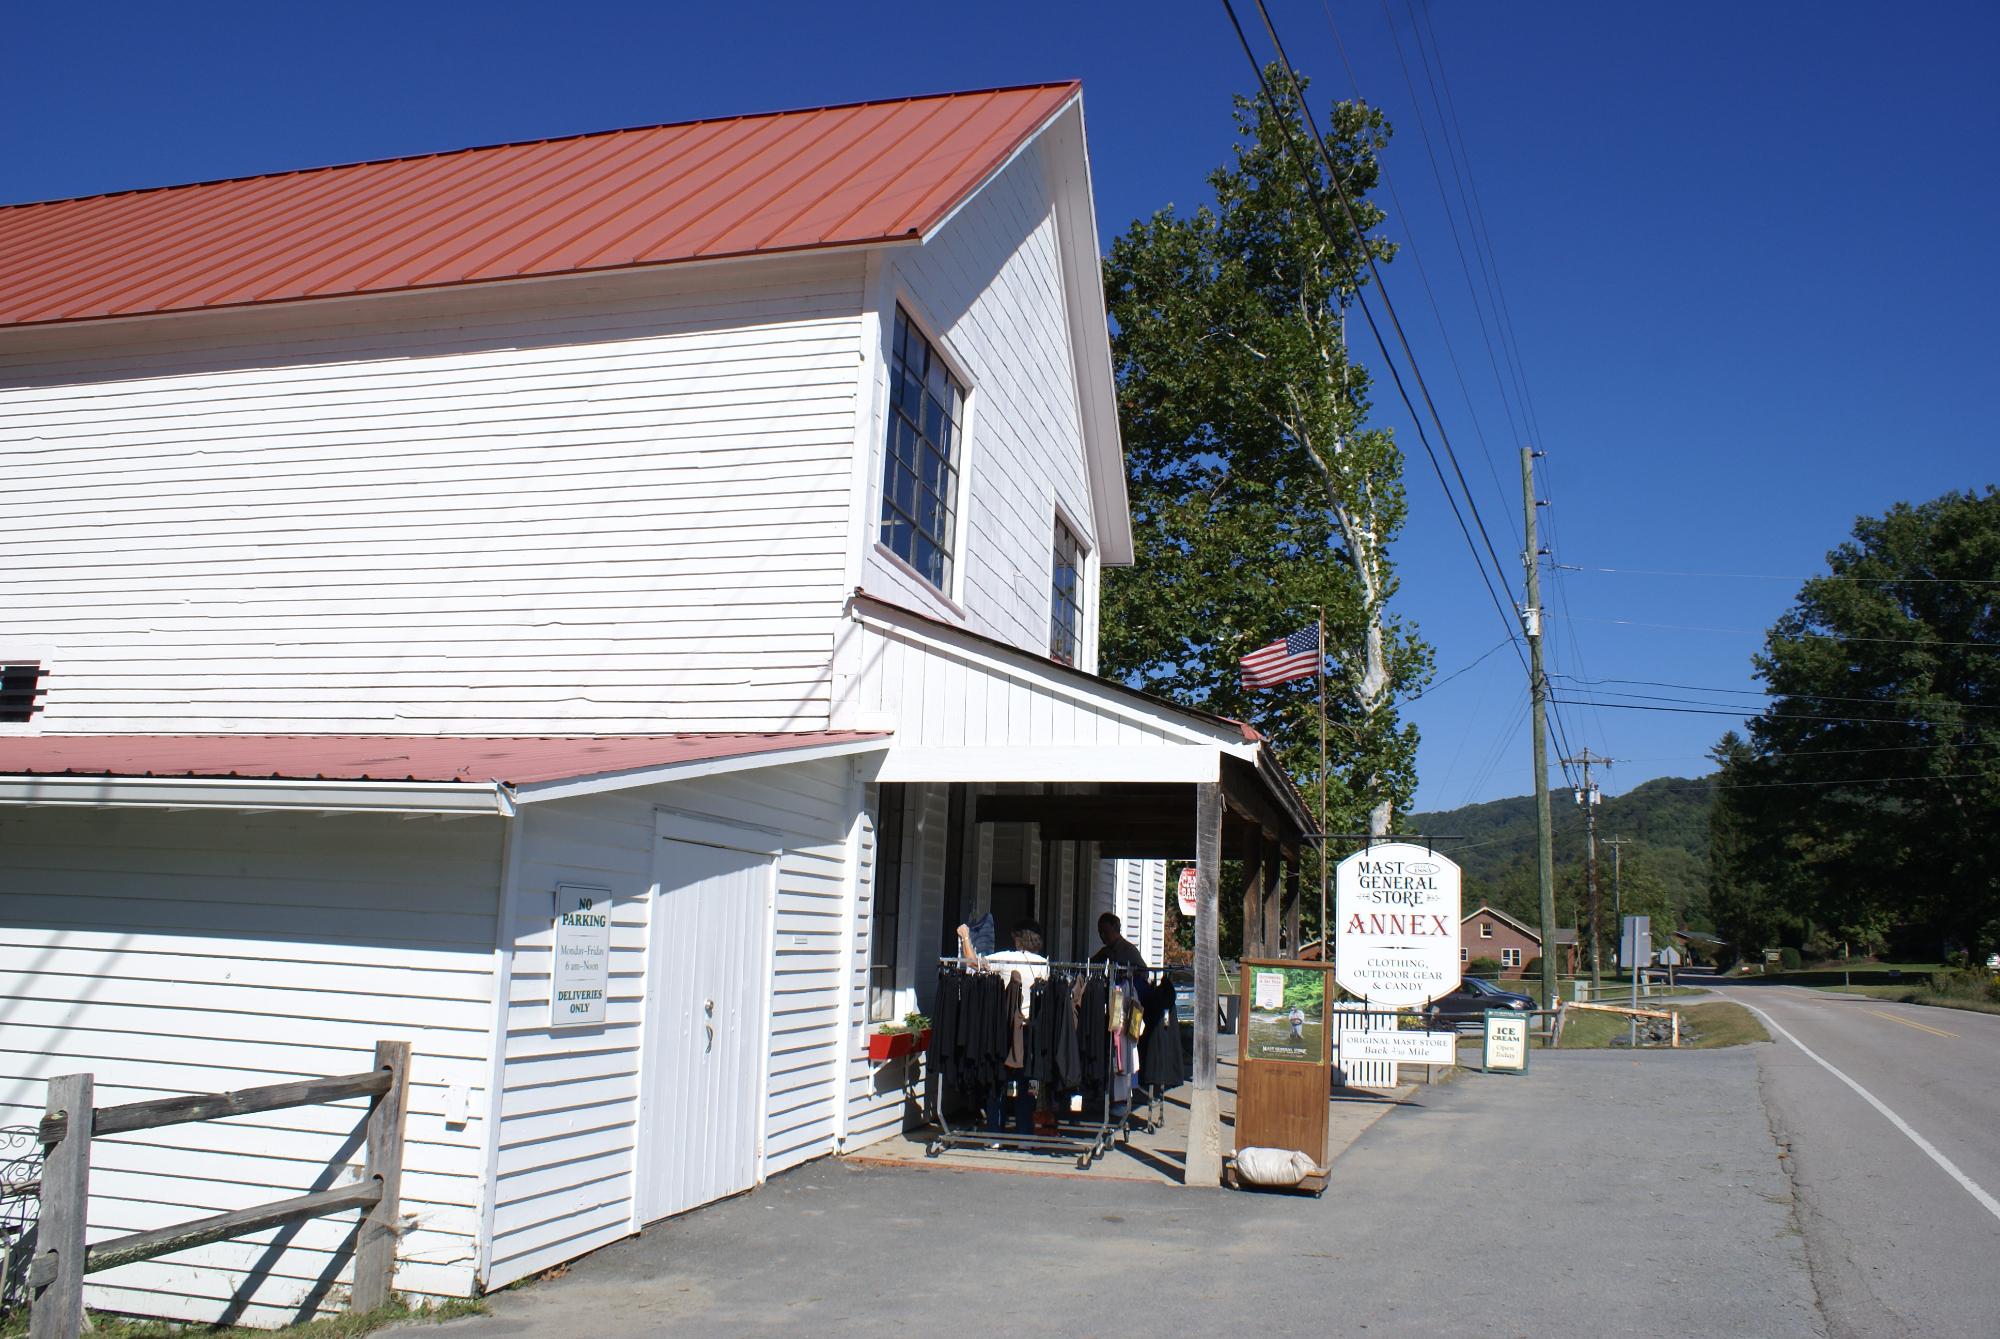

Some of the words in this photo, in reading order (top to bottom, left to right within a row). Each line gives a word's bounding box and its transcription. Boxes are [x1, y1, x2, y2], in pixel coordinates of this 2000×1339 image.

[1358, 861, 1405, 877] MAST
[1360, 876, 1437, 890] GENERAL
[1372, 890, 1424, 907] STORE
[578, 898, 592, 911] NO
[562, 913, 606, 928] PARKING
[1346, 913, 1449, 936] ANNEX
[1367, 958, 1429, 969] CLOTHING,
[1353, 969, 1410, 979] OUTDOOR
[1413, 971, 1443, 980] GEAR
[1372, 981, 1381, 990] &
[1385, 981, 1424, 990] CANDY
[558, 989, 603, 1001] DELIVERIES
[570, 1003, 590, 1014] ONLY
[1497, 1027, 1516, 1035] ICE
[1346, 1036, 1390, 1045] ORIGINAL
[1393, 1038, 1418, 1046] MAST
[1420, 1039, 1448, 1047] STORE
[1364, 1046, 1388, 1055] Back
[1408, 1047, 1430, 1056] Mile
